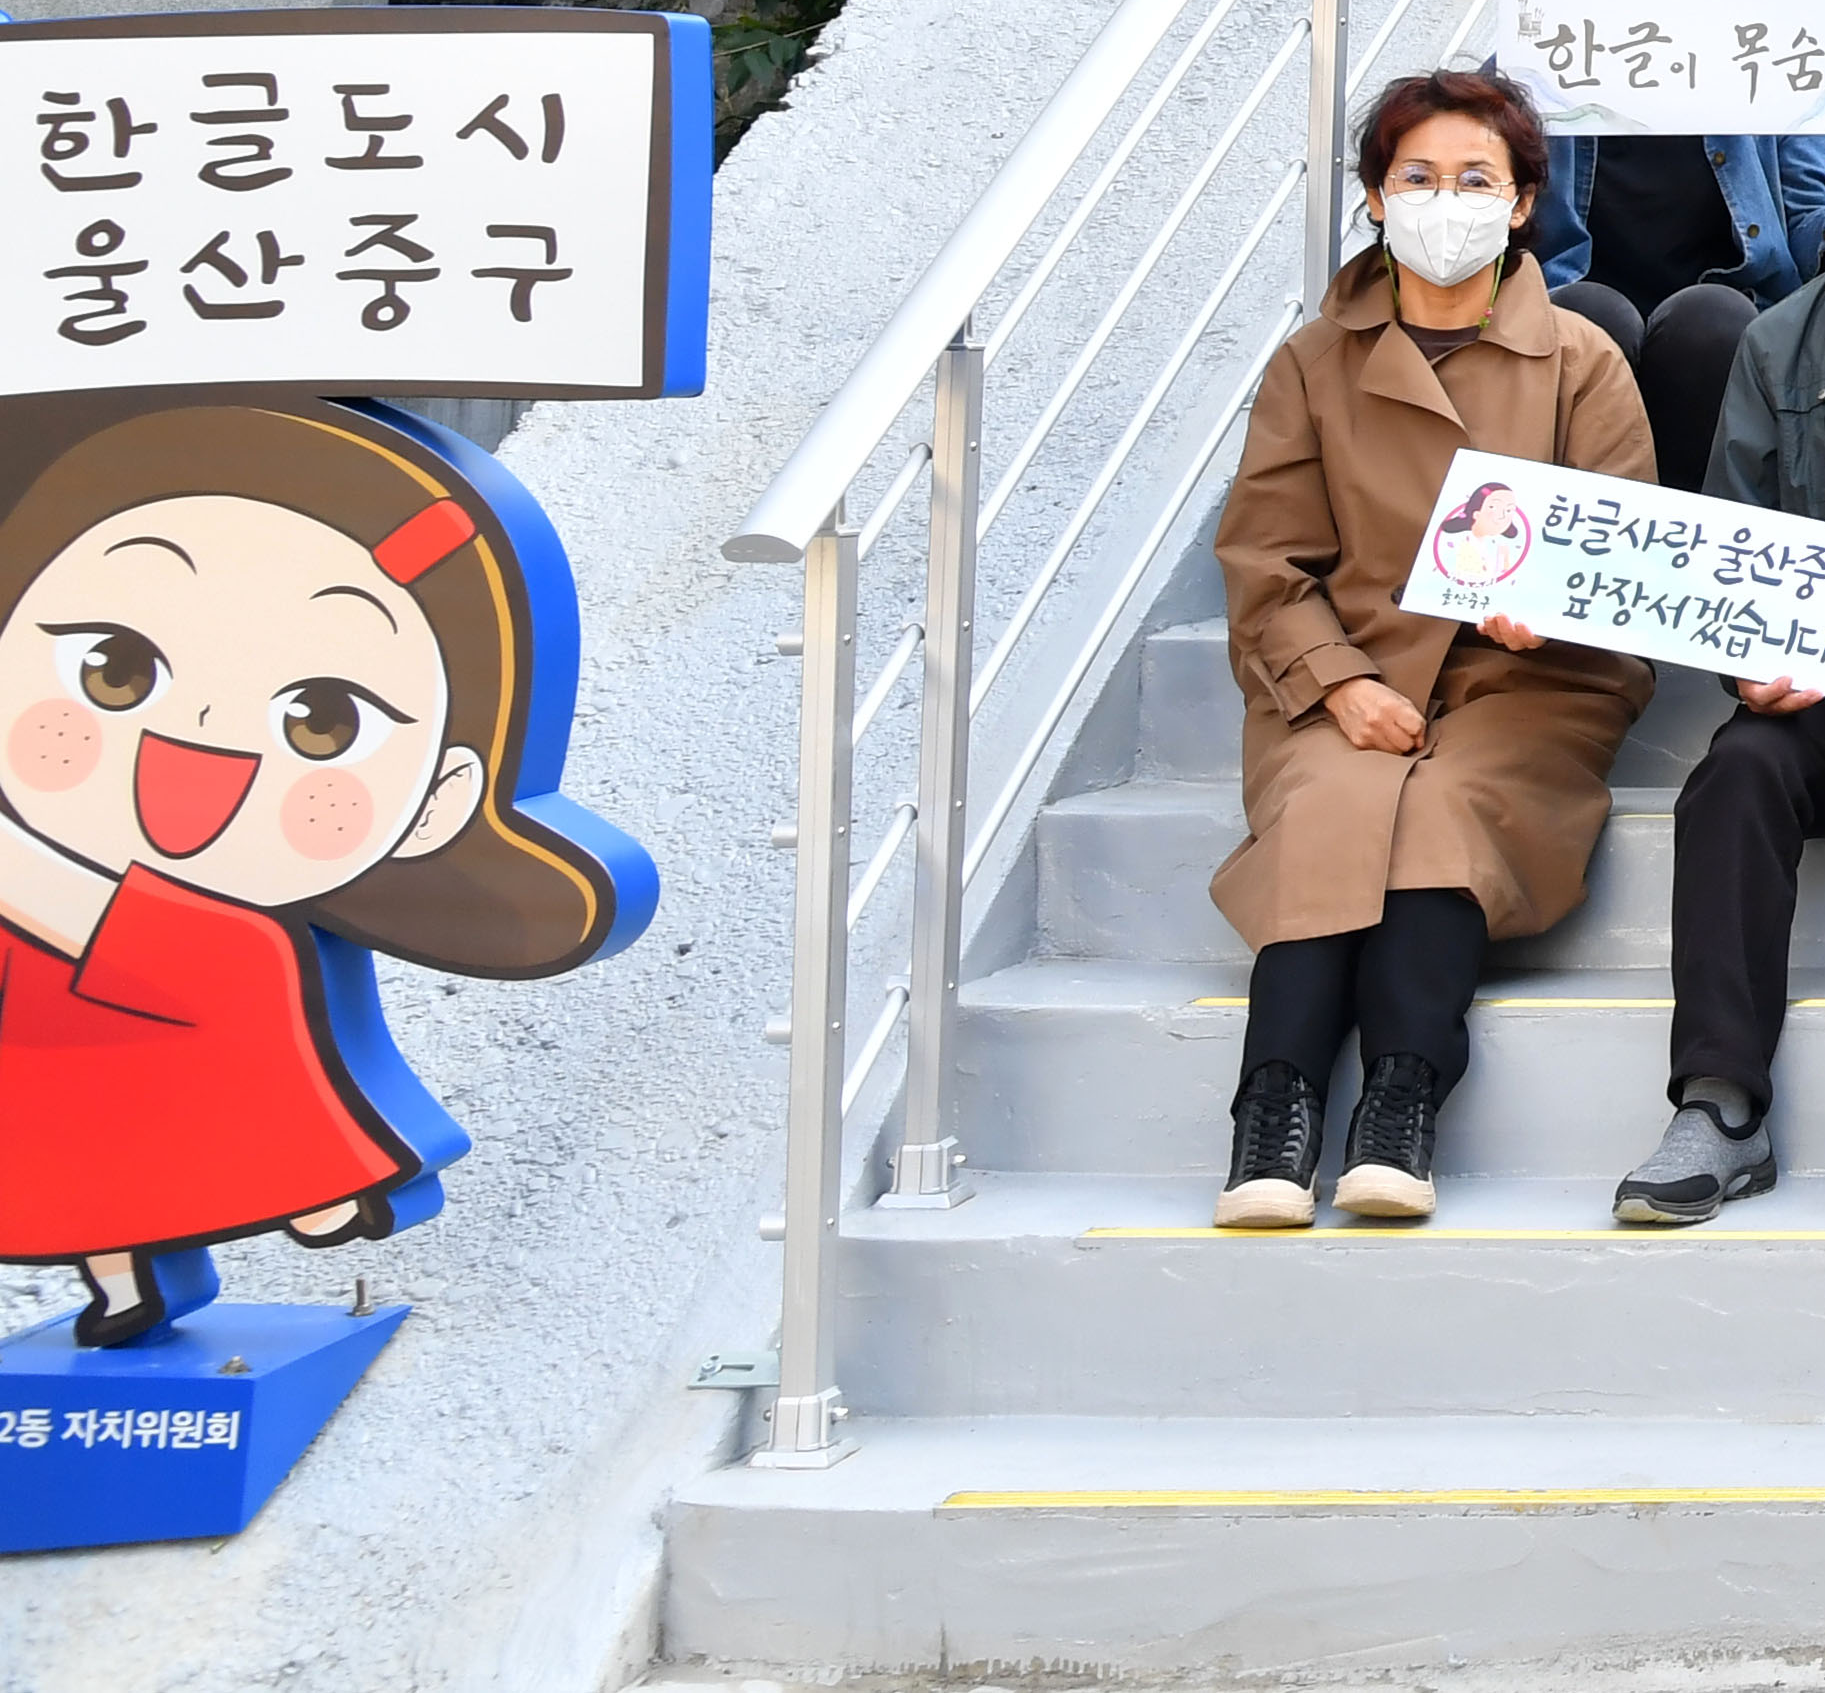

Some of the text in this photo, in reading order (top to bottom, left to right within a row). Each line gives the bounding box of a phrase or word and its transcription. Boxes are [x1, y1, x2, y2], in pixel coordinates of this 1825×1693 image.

[1534, 19, 1825, 105] 한글이 목숨
[36, 73, 565, 192] 한글도시
[44, 214, 573, 346] 울산중구
[1541, 494, 1708, 570] 한글사랑
[61, 1409, 240, 1450] 자치위원회
